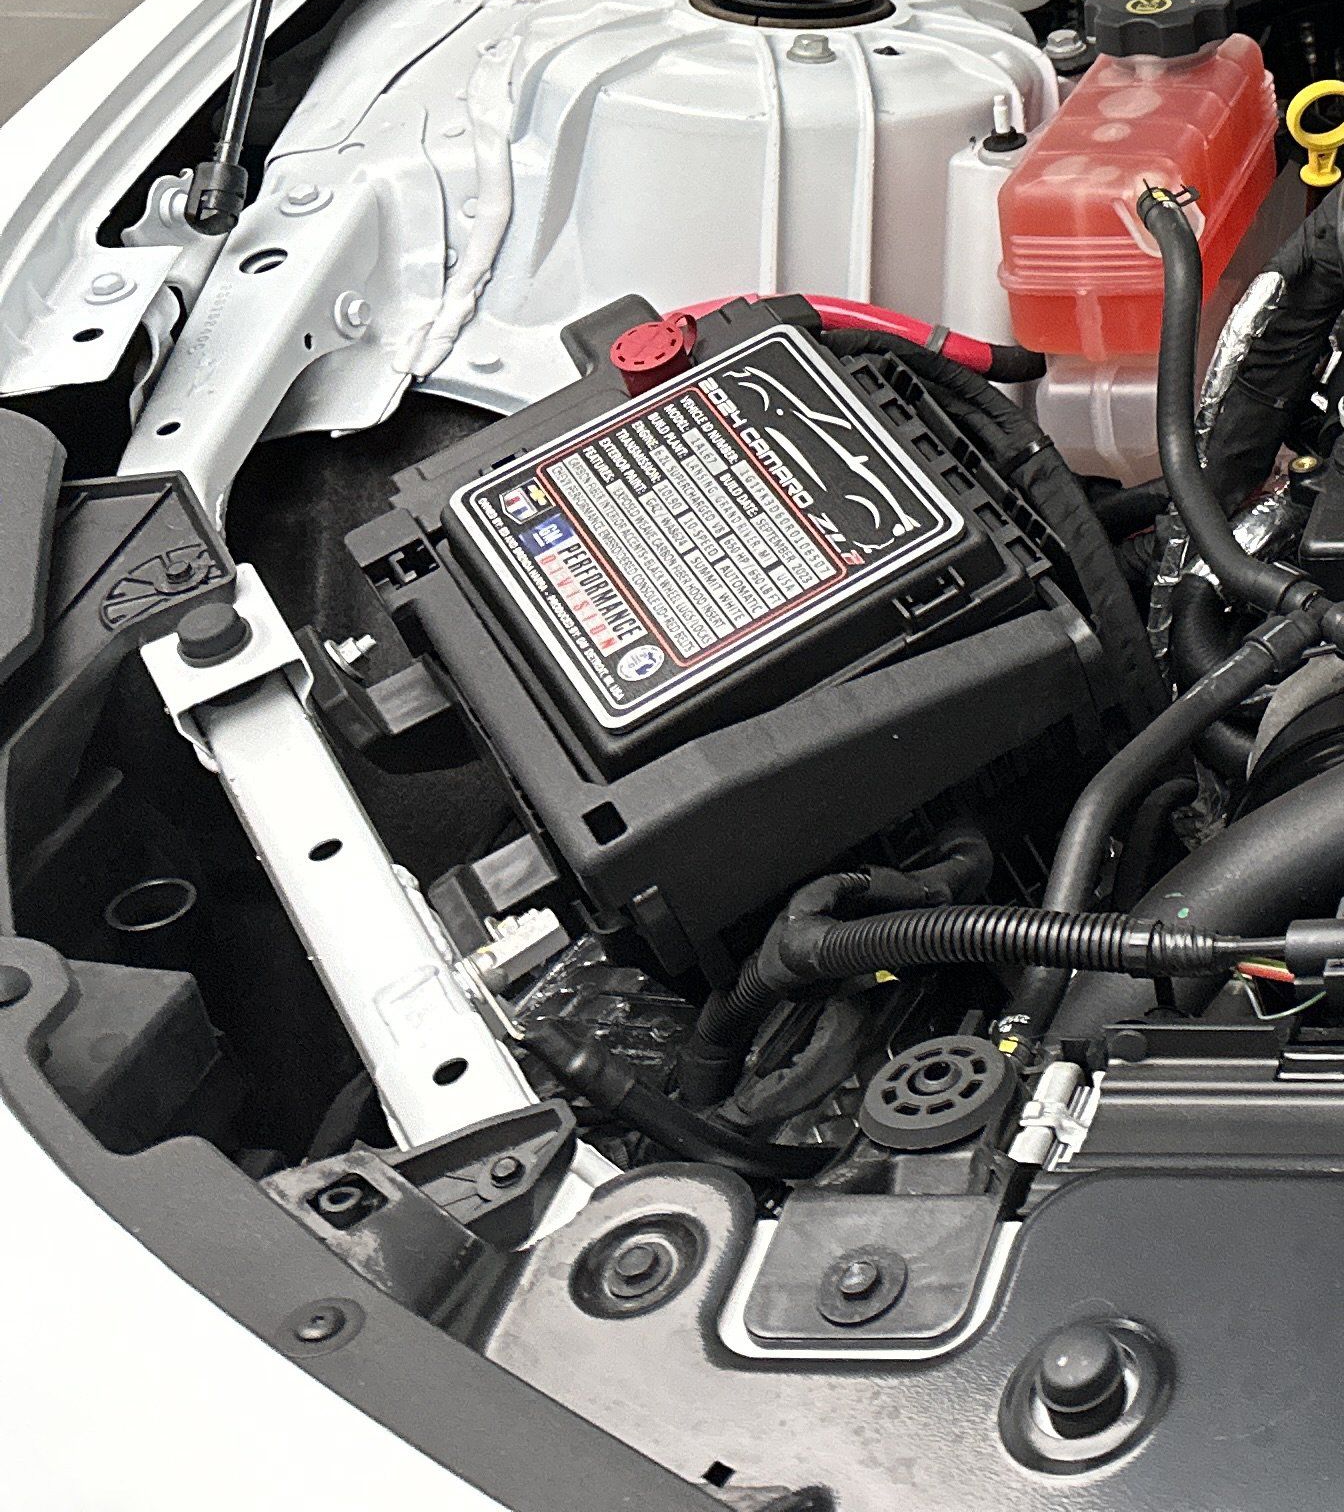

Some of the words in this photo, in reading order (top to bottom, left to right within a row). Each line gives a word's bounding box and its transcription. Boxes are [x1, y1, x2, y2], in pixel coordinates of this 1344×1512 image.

[678, 395, 708, 425] VEHICLE
[697, 375, 748, 428] 2024
[738, 425, 815, 509] CAMARO
[699, 421, 714, 433] ID
[706, 429, 740, 465] NUMBER:
[536, 522, 564, 545] GM
[597, 436, 631, 473] EXTERIOR
[621, 468, 649, 495] PAINT:
[689, 555, 723, 592] SUMMIT
[717, 591, 745, 621] WHITE
[614, 428, 663, 484] TRANSMISSION:
[683, 517, 719, 557] 10-SPEED
[719, 563, 763, 613] AUTOMATIC
[646, 411, 670, 434] BUILD
[662, 431, 689, 459] PLANT:
[713, 494, 742, 524] GRAND
[775, 572, 796, 591] USA
[662, 403, 691, 432] MODEL:
[718, 472, 744, 497] BUILD
[735, 493, 760, 517] DATE:
[755, 517, 796, 563] SEPTEMBER
[791, 562, 813, 584] 2023
[665, 464, 716, 522] SUPERCHARGED
[556, 541, 642, 641] PERFORMANCE
[611, 487, 641, 518] EXPOSED
[633, 515, 658, 540] WEAVE
[650, 537, 678, 566] CARBON
[684, 582, 708, 606] HOOD
[700, 602, 726, 629] INSERT
[657, 578, 683, 604] WHEEL
[723, 537, 741, 554] 650
[734, 551, 749, 565] HP
[758, 583, 773, 595] LB
[766, 593, 781, 605] FT
[538, 553, 618, 650] DIVISION
[630, 572, 660, 605] CONSOLE
[662, 616, 681, 633] RED
